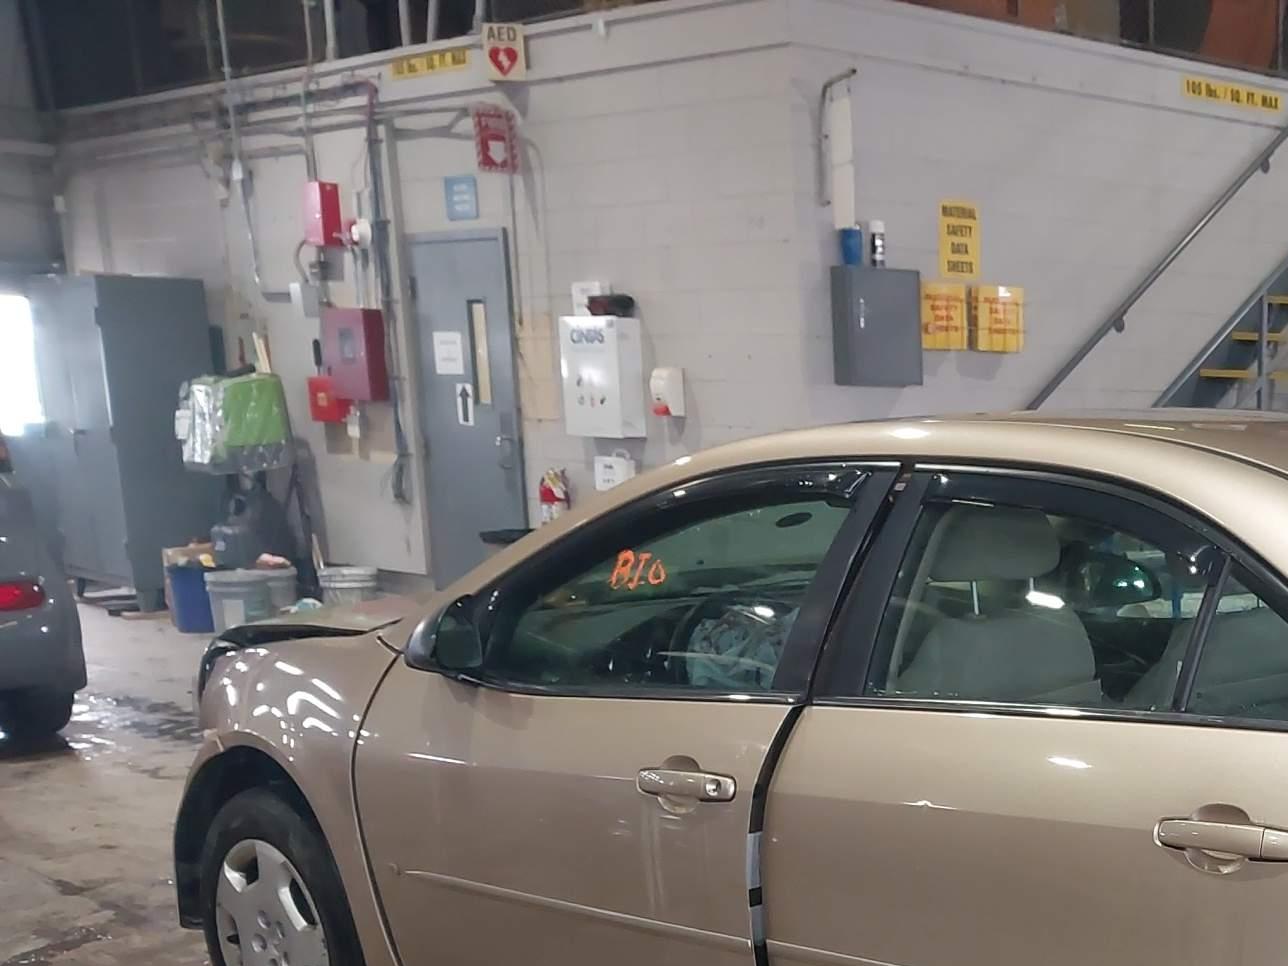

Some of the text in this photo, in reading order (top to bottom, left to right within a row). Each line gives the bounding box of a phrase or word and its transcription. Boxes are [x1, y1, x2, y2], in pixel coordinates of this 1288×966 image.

[487, 26, 517, 41] AED
[1246, 91, 1258, 106] FT.
[1261, 95, 1278, 109] MAX
[942, 204, 976, 220] MATERIAL
[946, 223, 972, 238] SAFETY
[951, 241, 969, 255] DATA
[947, 260, 973, 274] SHEETS
